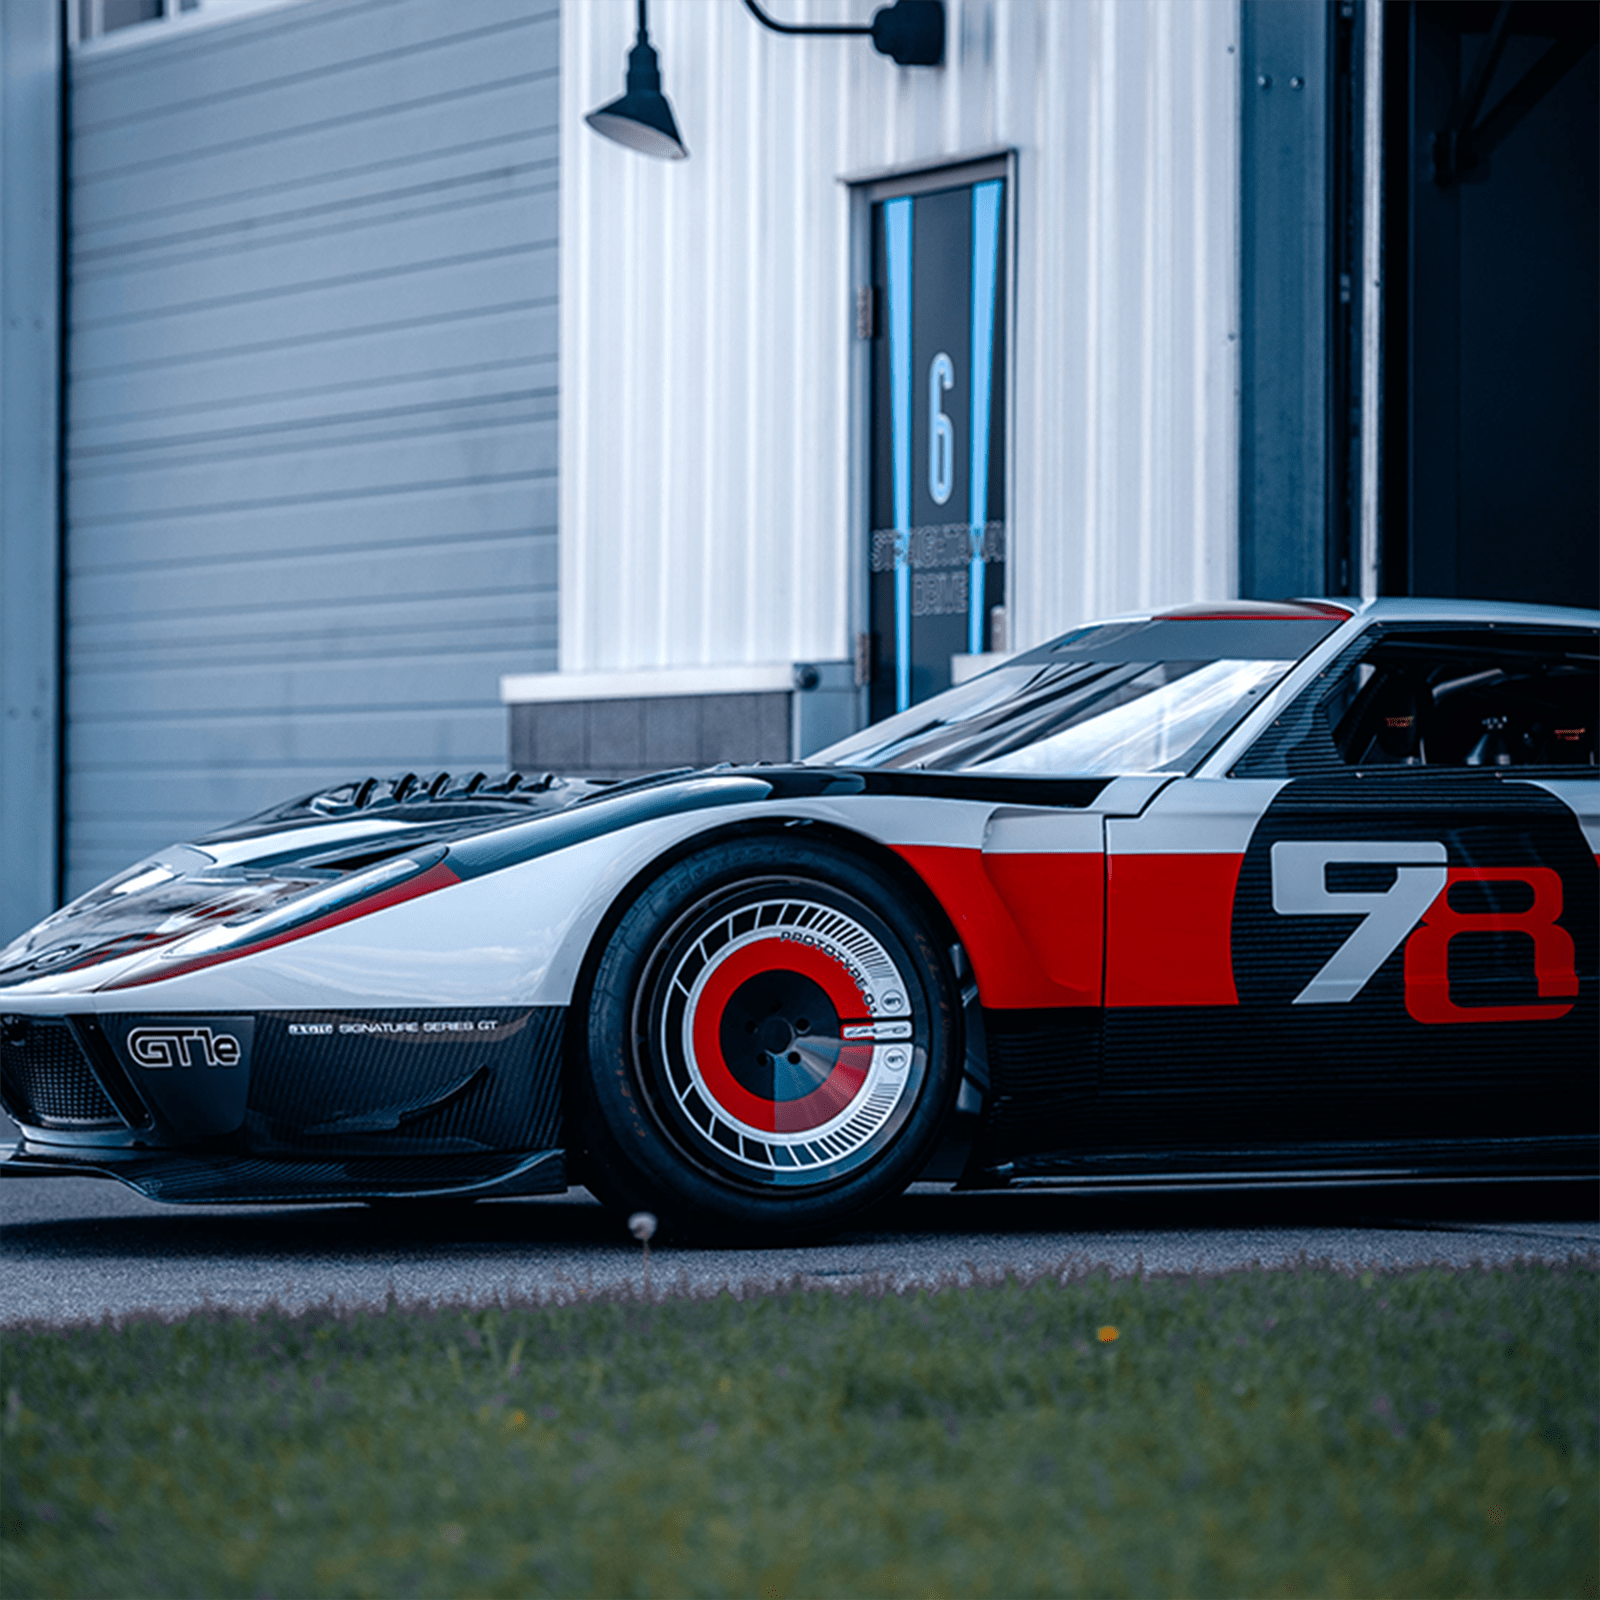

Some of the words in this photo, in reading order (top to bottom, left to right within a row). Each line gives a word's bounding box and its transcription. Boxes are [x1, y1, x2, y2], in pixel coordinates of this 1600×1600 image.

[929, 352, 954, 505] 6
[780, 931, 868, 991] PROTOTYPE
[1271, 841, 1579, 1024] 98
[127, 1027, 241, 1067] GT1e
[339, 1022, 418, 1034] SIGNATURE
[423, 1021, 474, 1032] SERIES
[477, 1020, 498, 1031] GT
